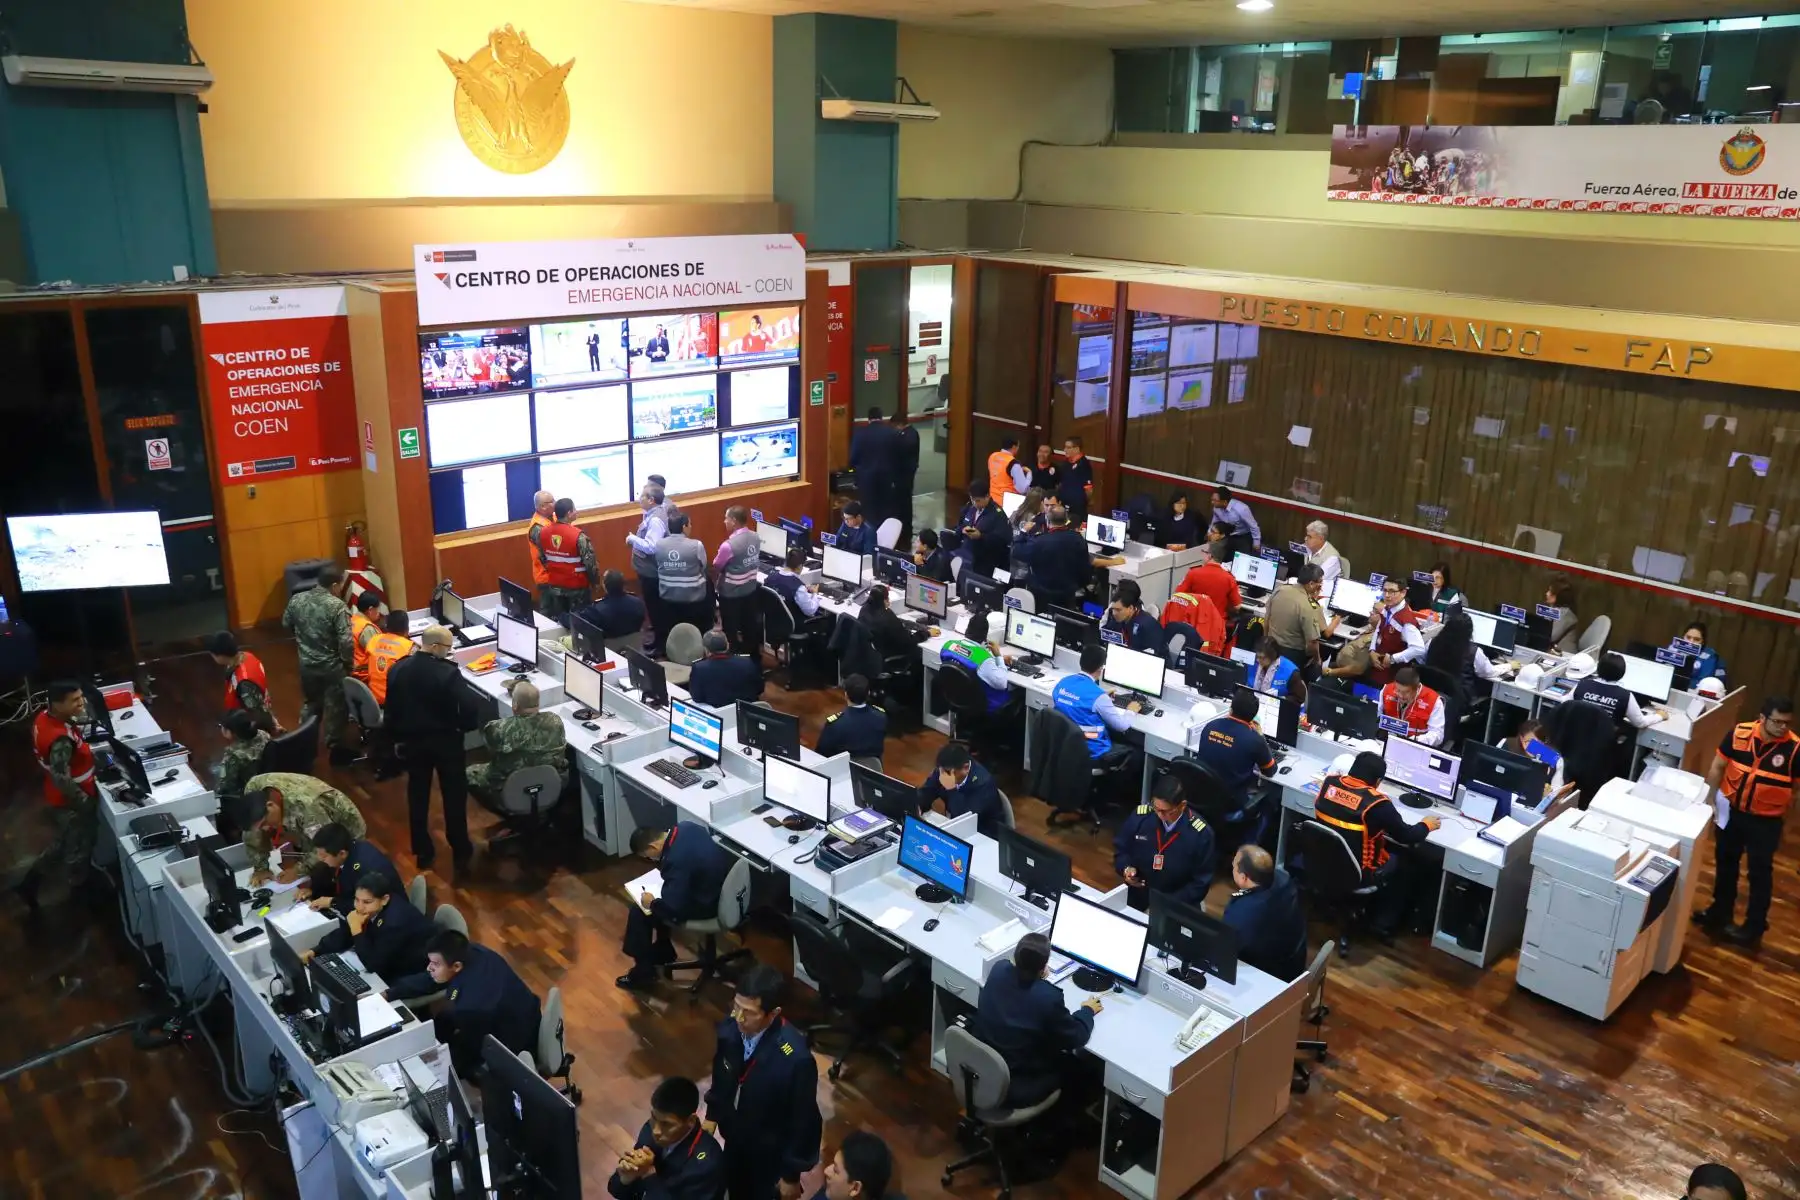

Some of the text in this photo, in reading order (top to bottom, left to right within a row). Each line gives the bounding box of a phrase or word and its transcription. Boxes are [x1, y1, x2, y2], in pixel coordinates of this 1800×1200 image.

[1585, 182, 1798, 200] Fuerza Aérea, LA FUERZA de
[455, 262, 705, 288] CENTRO DE OPERACIONES DE
[568, 284, 669, 304] EMERGENCIA
[673, 281, 742, 298] NACIONAL
[755, 278, 793, 294] COEN
[1218, 296, 1346, 332] PUESTO
[1363, 311, 1543, 356] COMANDO
[1624, 339, 1714, 375] FAP
[225, 347, 310, 365] CENTRO DE
[227, 361, 341, 381] OPERACIONES DE
[229, 379, 323, 399] EMERGENCIA
[231, 398, 304, 416] NACIONAL
[234, 417, 289, 438] COEN
[1584, 691, 1619, 706] COE-MTC
